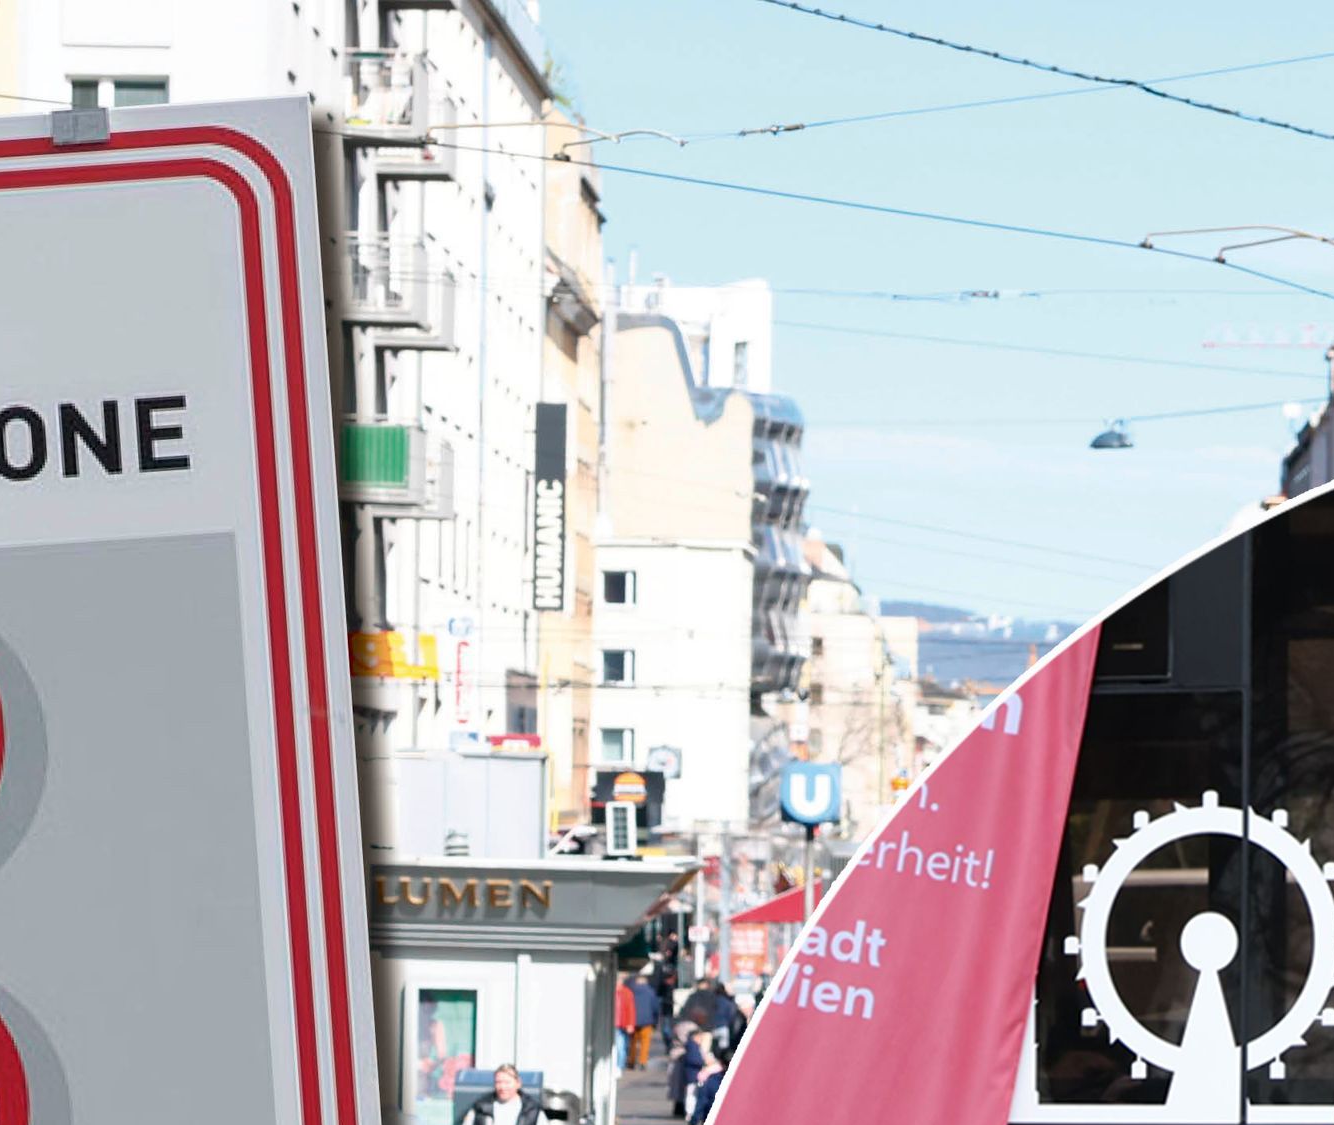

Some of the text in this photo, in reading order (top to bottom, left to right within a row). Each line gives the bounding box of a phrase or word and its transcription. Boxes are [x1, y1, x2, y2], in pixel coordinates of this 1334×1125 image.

[535, 479, 564, 608] HUMANIC
[789, 773, 831, 819] U
[374, 875, 554, 909] LUMEN
